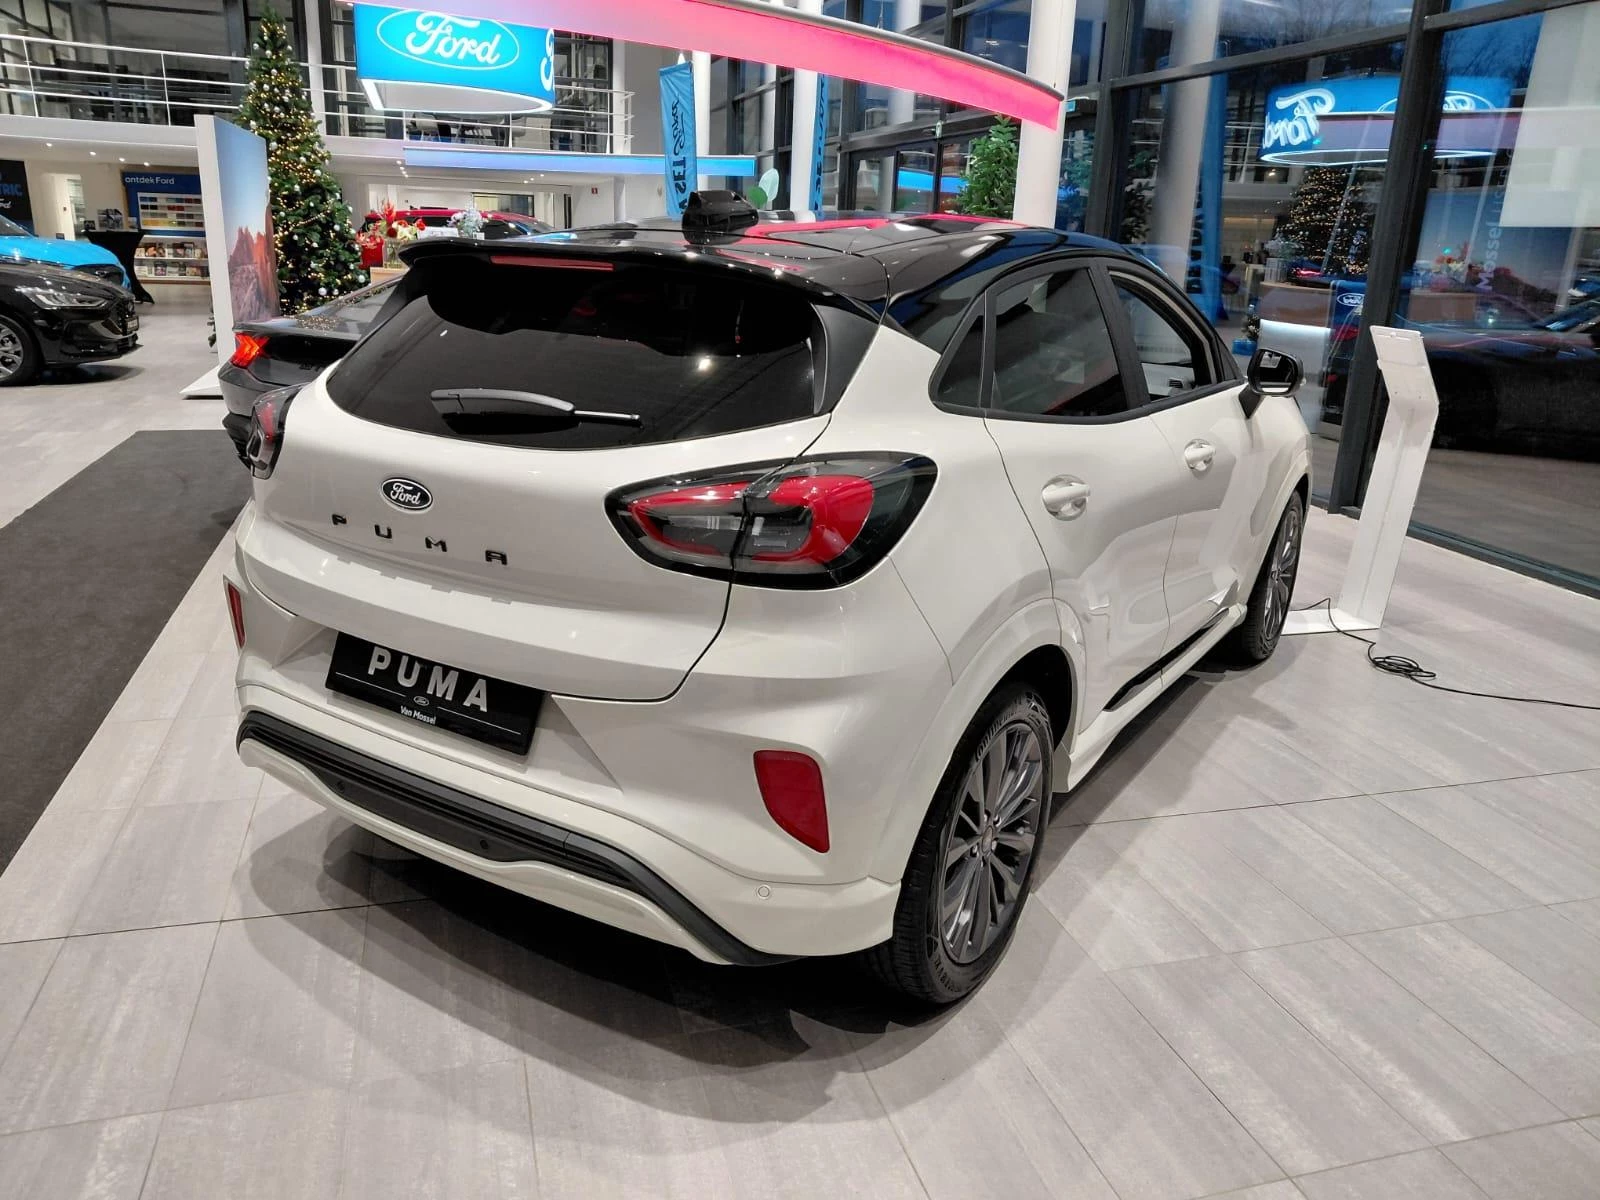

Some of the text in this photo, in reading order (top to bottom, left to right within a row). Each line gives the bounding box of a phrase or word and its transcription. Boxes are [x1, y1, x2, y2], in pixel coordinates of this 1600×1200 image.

[405, 11, 502, 65] Ford
[125, 176, 175, 185] ontdek Ford
[1476, 221, 1502, 291] Mossel
[390, 482, 421, 505] Ford
[332, 513, 508, 566] PUMA
[367, 645, 489, 713] PUMA
[400, 705, 437, 725] Van Mossel
